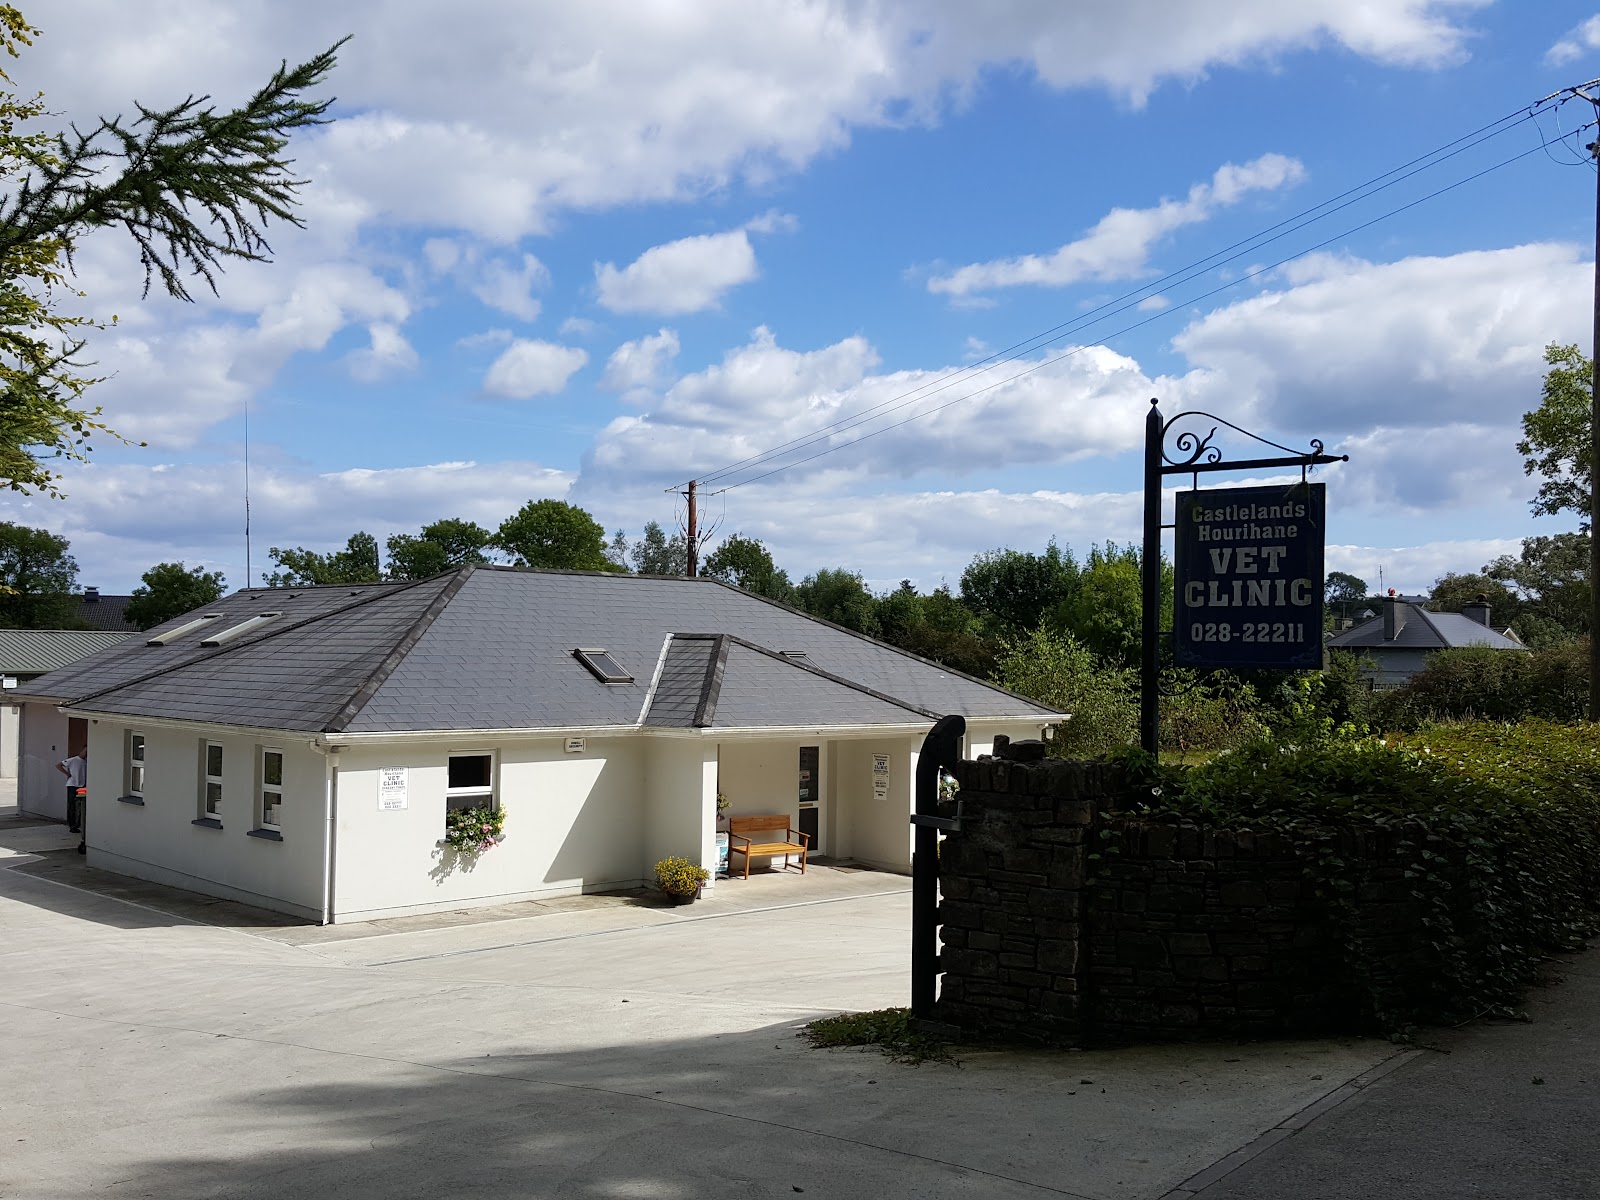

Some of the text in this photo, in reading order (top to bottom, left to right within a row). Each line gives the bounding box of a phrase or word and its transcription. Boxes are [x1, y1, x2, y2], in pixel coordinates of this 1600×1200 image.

[1192, 501, 1305, 522] Castlelands
[1198, 523, 1297, 541] Hourihane
[1209, 546, 1286, 574] VET
[1184, 578, 1312, 607] CLINIC
[1191, 623, 1304, 642] 028-22211
